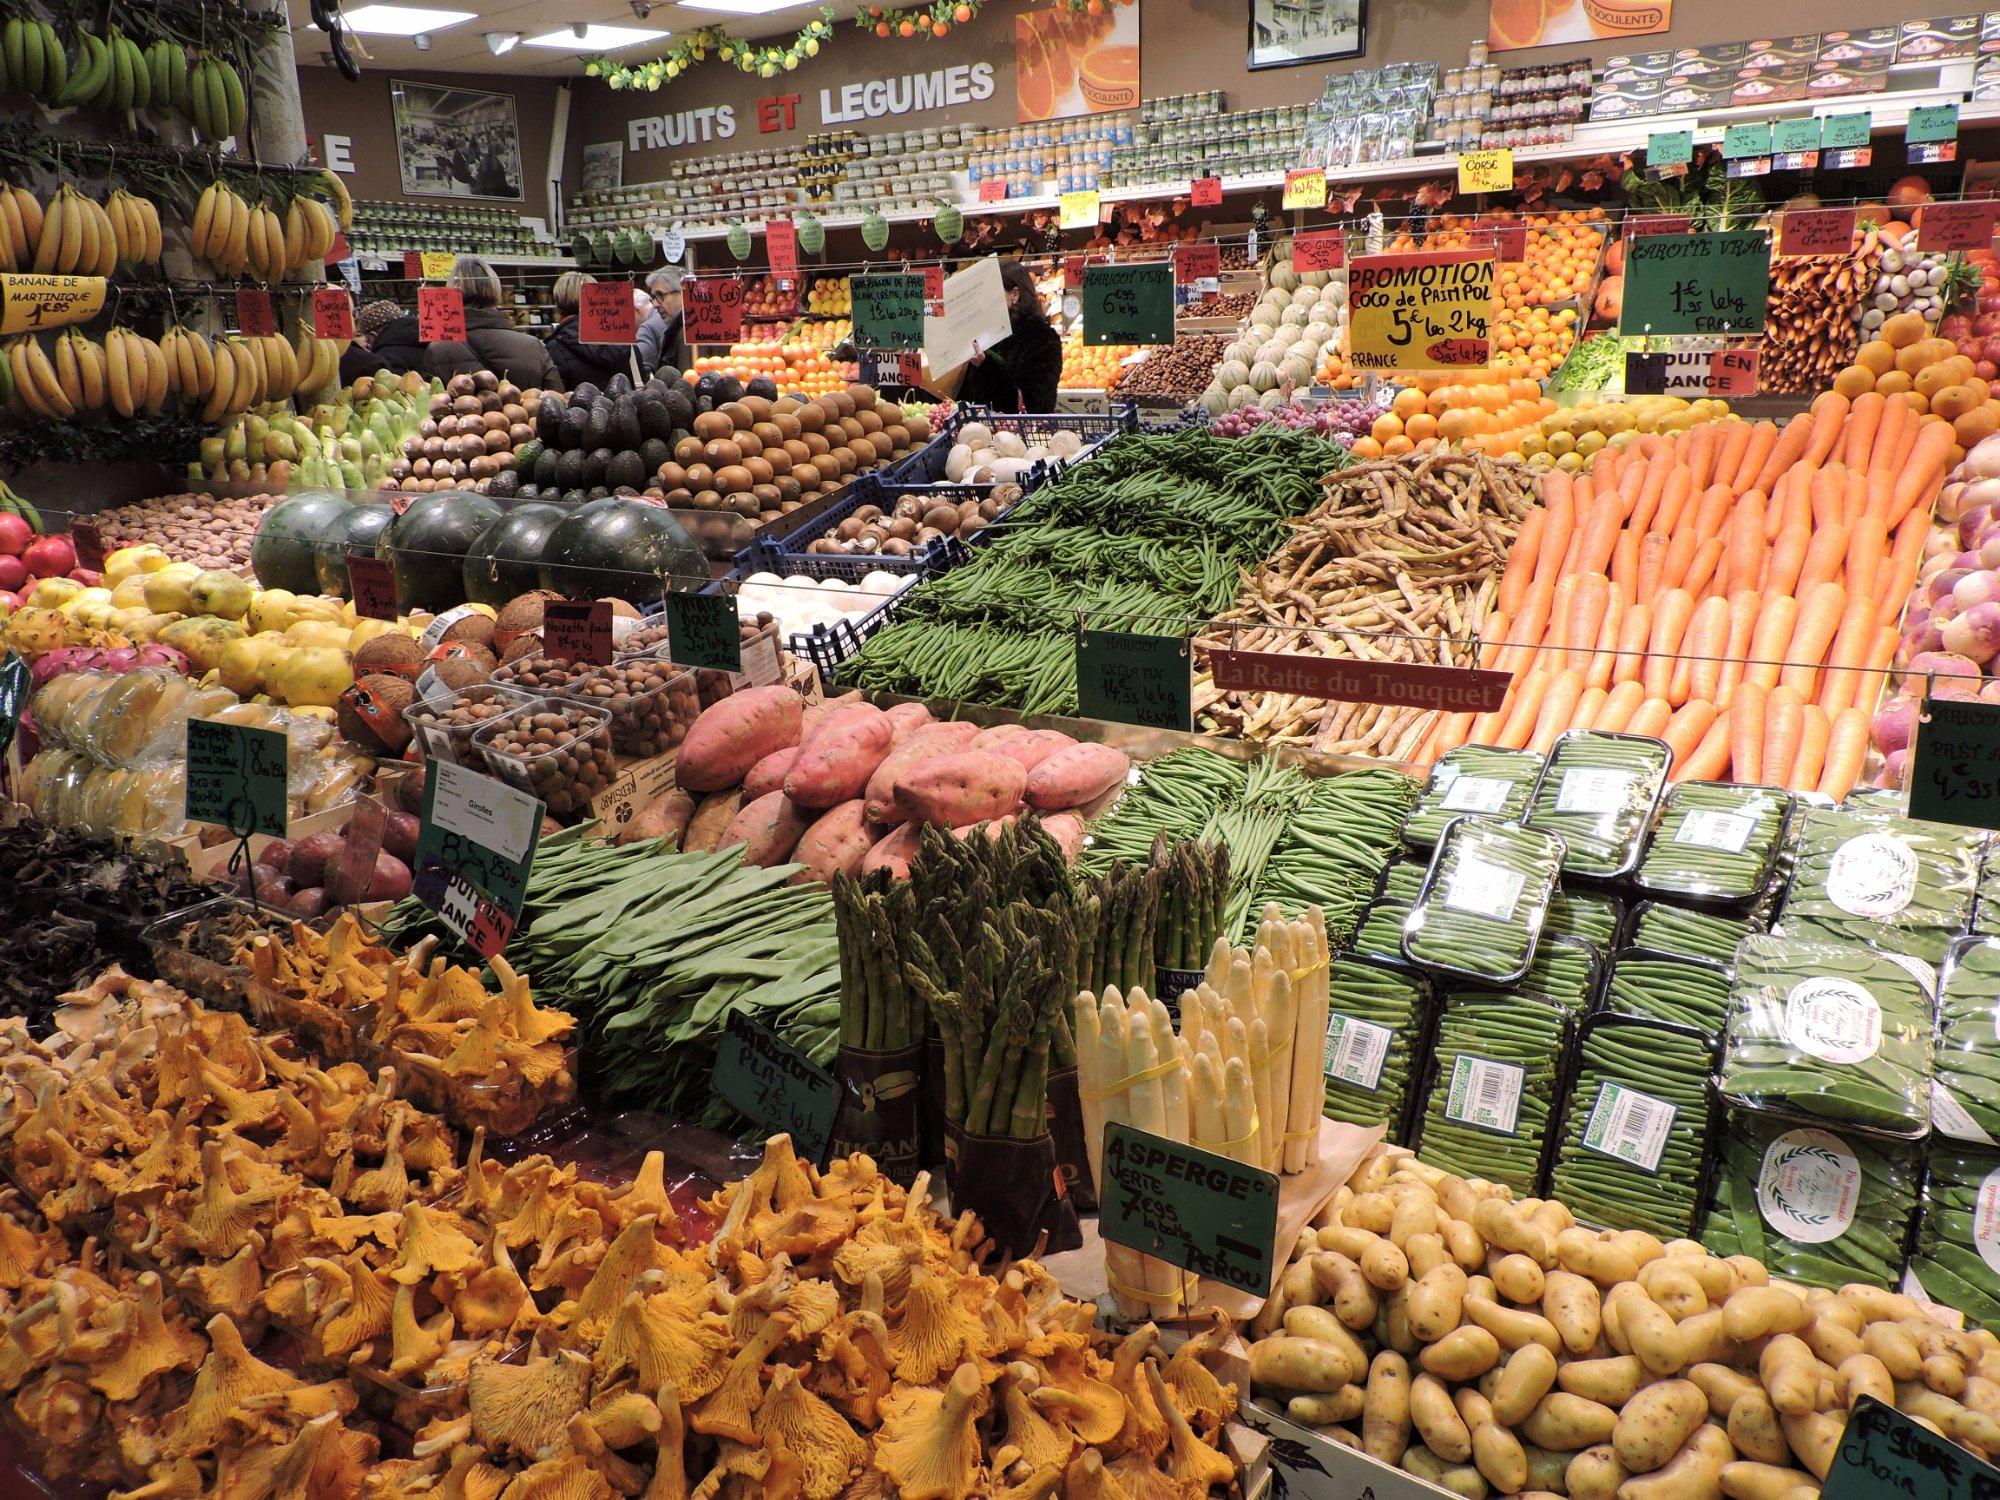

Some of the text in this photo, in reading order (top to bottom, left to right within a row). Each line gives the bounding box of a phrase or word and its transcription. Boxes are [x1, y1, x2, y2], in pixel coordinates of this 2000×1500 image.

[628, 62, 996, 153] FRUITS ET LEGUMES
[1632, 239, 1713, 261] CAROTTE
[9, 276, 78, 287] BANANE DE
[1082, 270, 1168, 287] HARICOT VERT
[1349, 261, 1494, 289] PROMOTION
[10, 292, 91, 302] MARTINIQUE
[1395, 291, 1417, 307] de
[1695, 317, 1754, 331] FRANCE
[906, 354, 919, 370] EN
[1351, 352, 1398, 368] FRANCE
[1724, 354, 1752, 372] EN
[869, 372, 911, 385] FRANCE
[1646, 375, 1731, 390] FRANCE
[545, 618, 586, 633] Noisette
[1216, 659, 1493, 707] La Ratte du Touquet
[468, 799, 493, 816] Girolles
[738, 1047, 786, 1088] PLAT
